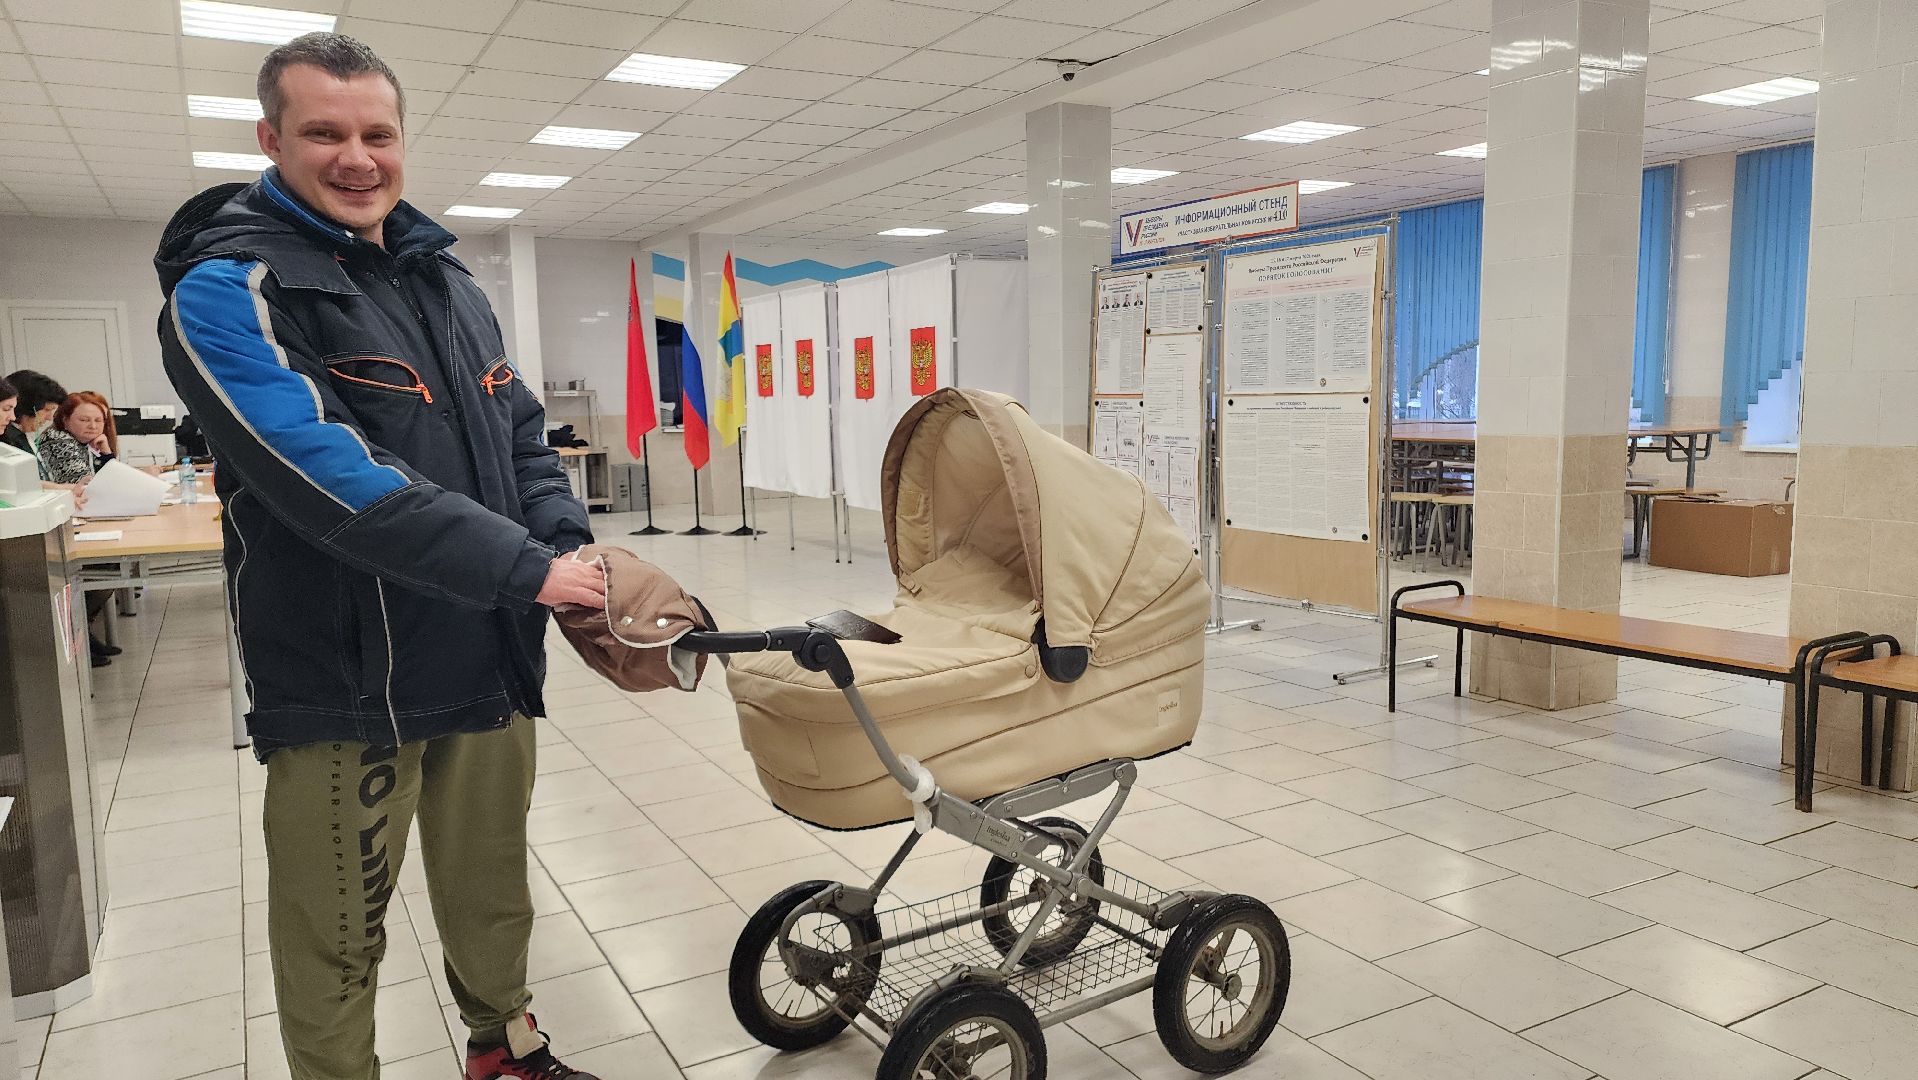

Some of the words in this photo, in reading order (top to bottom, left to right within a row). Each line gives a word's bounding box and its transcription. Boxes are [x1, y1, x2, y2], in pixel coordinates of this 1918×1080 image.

[1175, 199, 1257, 226] ИНФОРМАЦИОННЫЙ
[1259, 195, 1288, 211] СТЕНД
[330, 760, 342, 806] FEAR
[331, 823, 342, 845] NO
[335, 852, 347, 896] PAIN
[338, 912, 349, 932] NO
